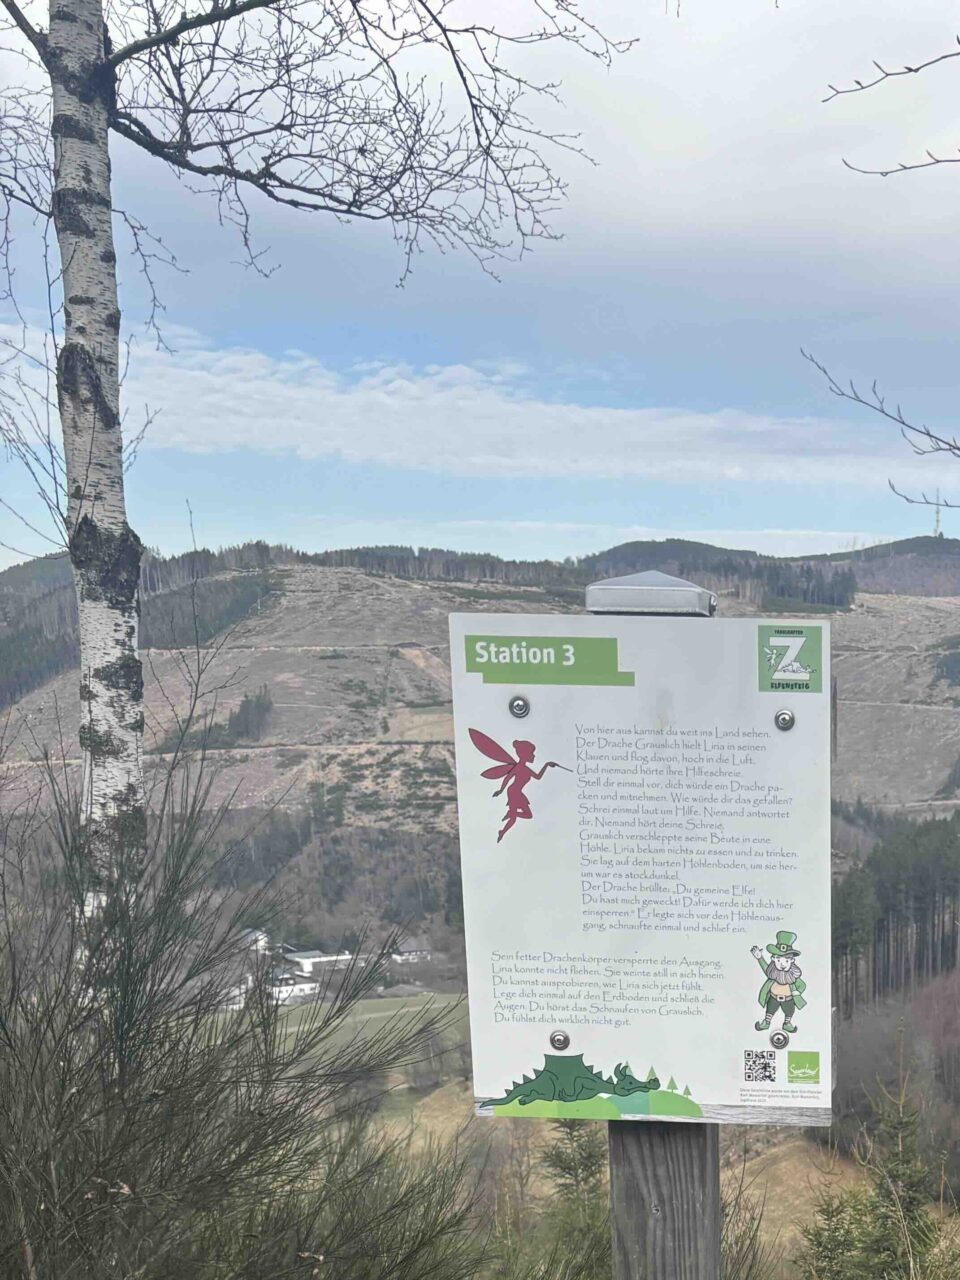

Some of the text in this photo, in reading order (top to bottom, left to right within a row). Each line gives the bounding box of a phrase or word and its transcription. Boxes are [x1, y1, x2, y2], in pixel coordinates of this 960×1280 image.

[475, 641, 576, 666] Station 3
[575, 723, 595, 734] Von
[597, 724, 615, 734] hier
[634, 725, 664, 735] kannst
[679, 728, 698, 736] weit
[715, 727, 740, 739] Land
[742, 728, 772, 739] sehen.
[576, 736, 767, 751] Der Drache Grauslich hielt Lina in seinen
[576, 750, 610, 761] Klauen
[612, 751, 629, 761] und
[631, 751, 649, 765] flog
[682, 753, 704, 763] hoch
[706, 756, 714, 764] in
[715, 754, 730, 764] die
[577, 763, 684, 776] Und niemand hörte ihre
[577, 776, 601, 788] Stell
[603, 777, 615, 787] dir
[617, 778, 645, 788] einmal
[664, 779, 684, 789] dich
[686, 780, 713, 790] würde
[715, 782, 728, 790] ein
[730, 781, 766, 792] Drache
[577, 789, 599, 800] cken
[600, 790, 618, 800] und
[670, 792, 690, 803] Wie
[691, 793, 719, 803] würde
[720, 793, 733, 804] dir
[735, 794, 752, 804] das
[577, 802, 611, 814] Schrei
[612, 804, 640, 814] einmal
[641, 804, 659, 814] laut
[703, 806, 745, 817] Niemand
[746, 810, 790, 818] antwortet
[595, 816, 636, 827] Niemand
[638, 817, 657, 828] hört
[658, 818, 684, 828] deine
[579, 829, 771, 844] Grauslich verschleppte seine Beute in eine
[614, 843, 635, 854] Lina
[637, 843, 666, 854] bekam
[668, 845, 694, 855] nichts
[735, 847, 752, 857] und
[766, 848, 800, 858] trinken.
[580, 855, 599, 866] Sie
[600, 855, 615, 869] lag
[615, 856, 631, 866] auf
[632, 856, 651, 866] dem
[652, 857, 682, 867] harten
[764, 862, 777, 870] sie
[581, 880, 602, 892] Der
[603, 881, 638, 892] Drache
[694, 886, 730, 897] gemeine
[582, 893, 598, 905] Du
[599, 894, 619, 904] hast
[621, 895, 641, 905] mich
[683, 896, 711, 908] Dafür
[712, 898, 740, 908] werde
[741, 898, 754, 908] ich
[756, 898, 775, 909] dich
[776, 899, 794, 909] hier
[637, 908, 651, 919] Er
[653, 908, 676, 921] legte
[677, 909, 695, 919] sich
[712, 910, 729, 920] den
[609, 920, 653, 931] schnaufte
[654, 922, 682, 932] einmal
[683, 922, 700, 932] und
[702, 923, 731, 933] schlief
[491, 950, 678, 967] Sein fetter Drachenkörper versperrte den
[492, 962, 697, 978] Lina konnte nicht Sie weinte still in sich
[492, 975, 704, 993] Du kannst wie Lina sich jetzt fühlt.
[493, 987, 517, 1000] Lege
[518, 988, 537, 998] dich
[538, 989, 566, 999] einmal
[567, 989, 581, 999] auf
[584, 990, 601, 1000] den
[603, 990, 650, 1002] Erdboden
[652, 992, 668, 1002] und
[701, 993, 716, 1003] die
[529, 1001, 545, 1012] Du
[547, 1001, 570, 1012] hörst
[571, 1002, 588, 1012] das
[589, 1002, 639, 1014] Schnaufen
[659, 1004, 704, 1016] Grauslich.
[494, 1012, 632, 1028] Du fühlst dich wirklich nicht gut.
